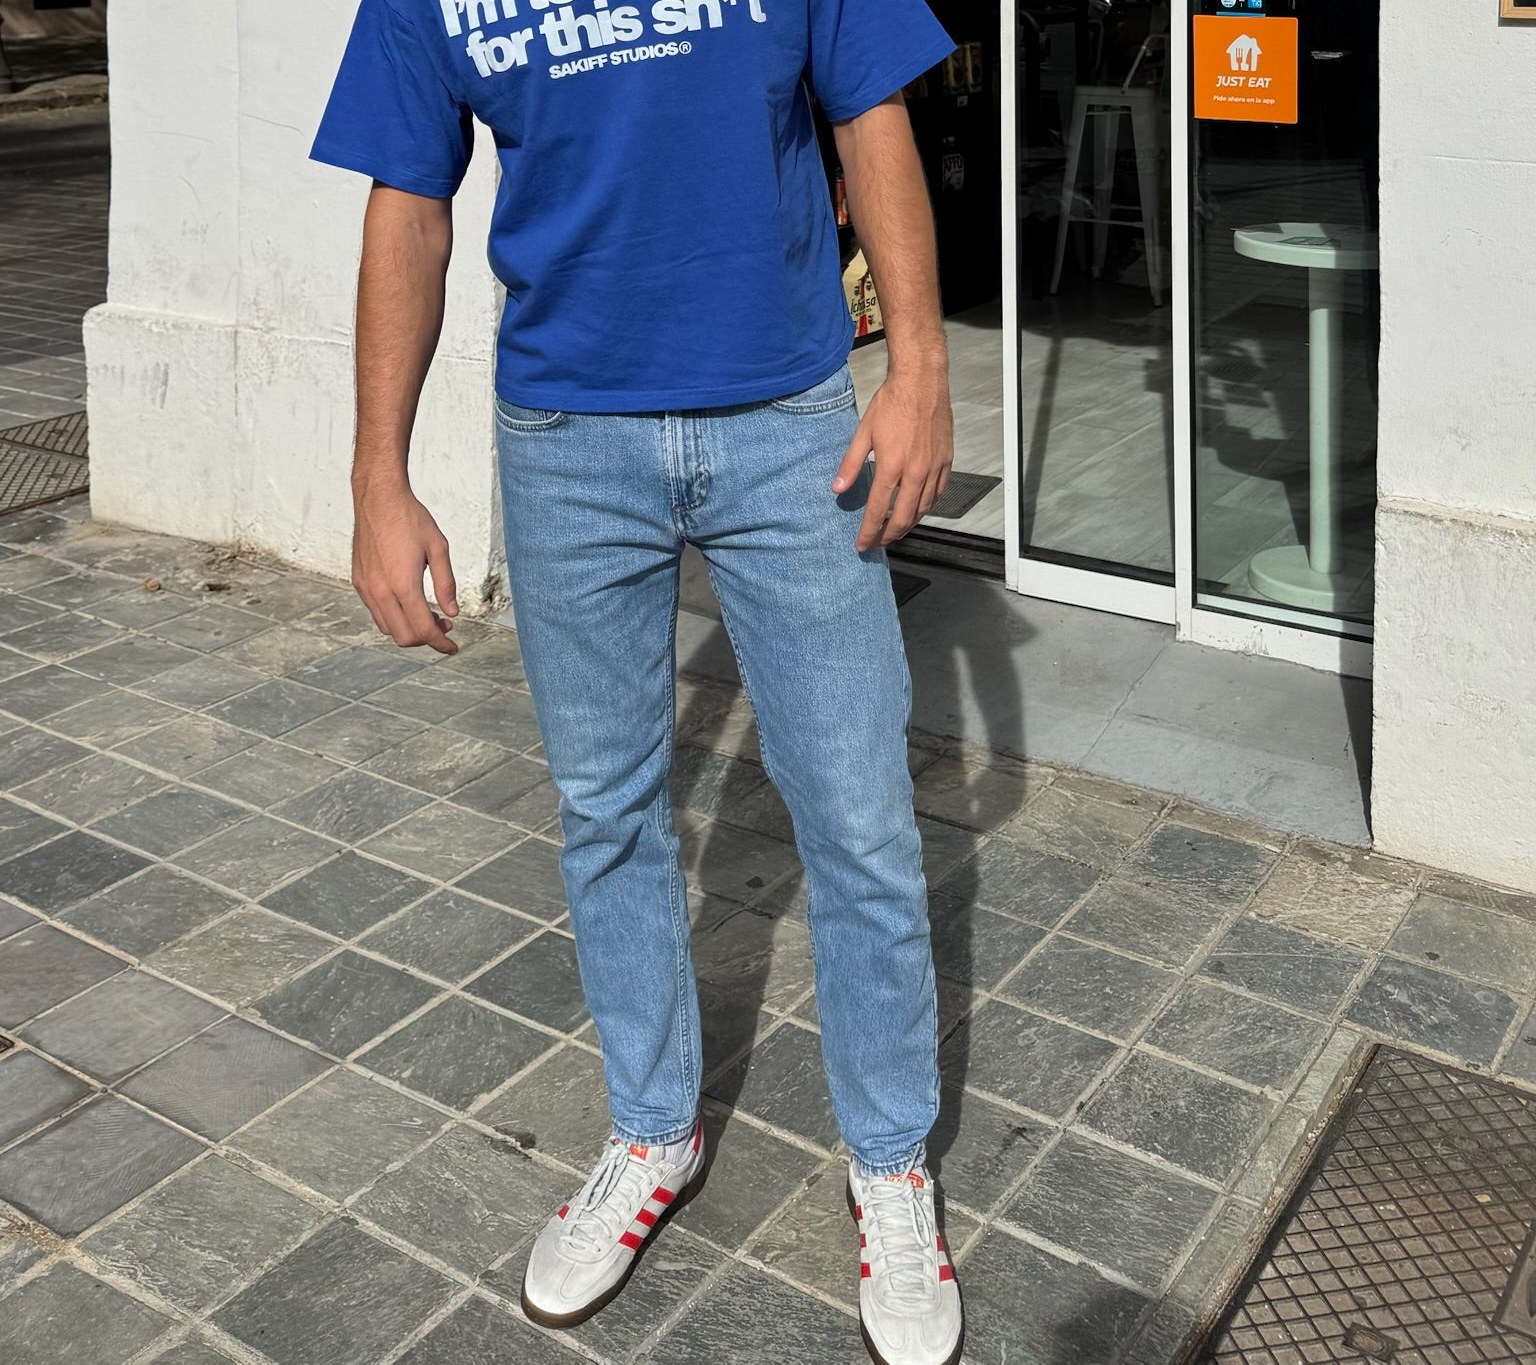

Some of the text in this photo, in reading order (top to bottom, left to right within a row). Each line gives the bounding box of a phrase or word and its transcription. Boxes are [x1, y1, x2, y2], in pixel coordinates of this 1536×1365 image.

[465, 26, 534, 78] for
[549, 53, 609, 80] SAKIFF
[1216, 75, 1272, 88] JUST EAT
